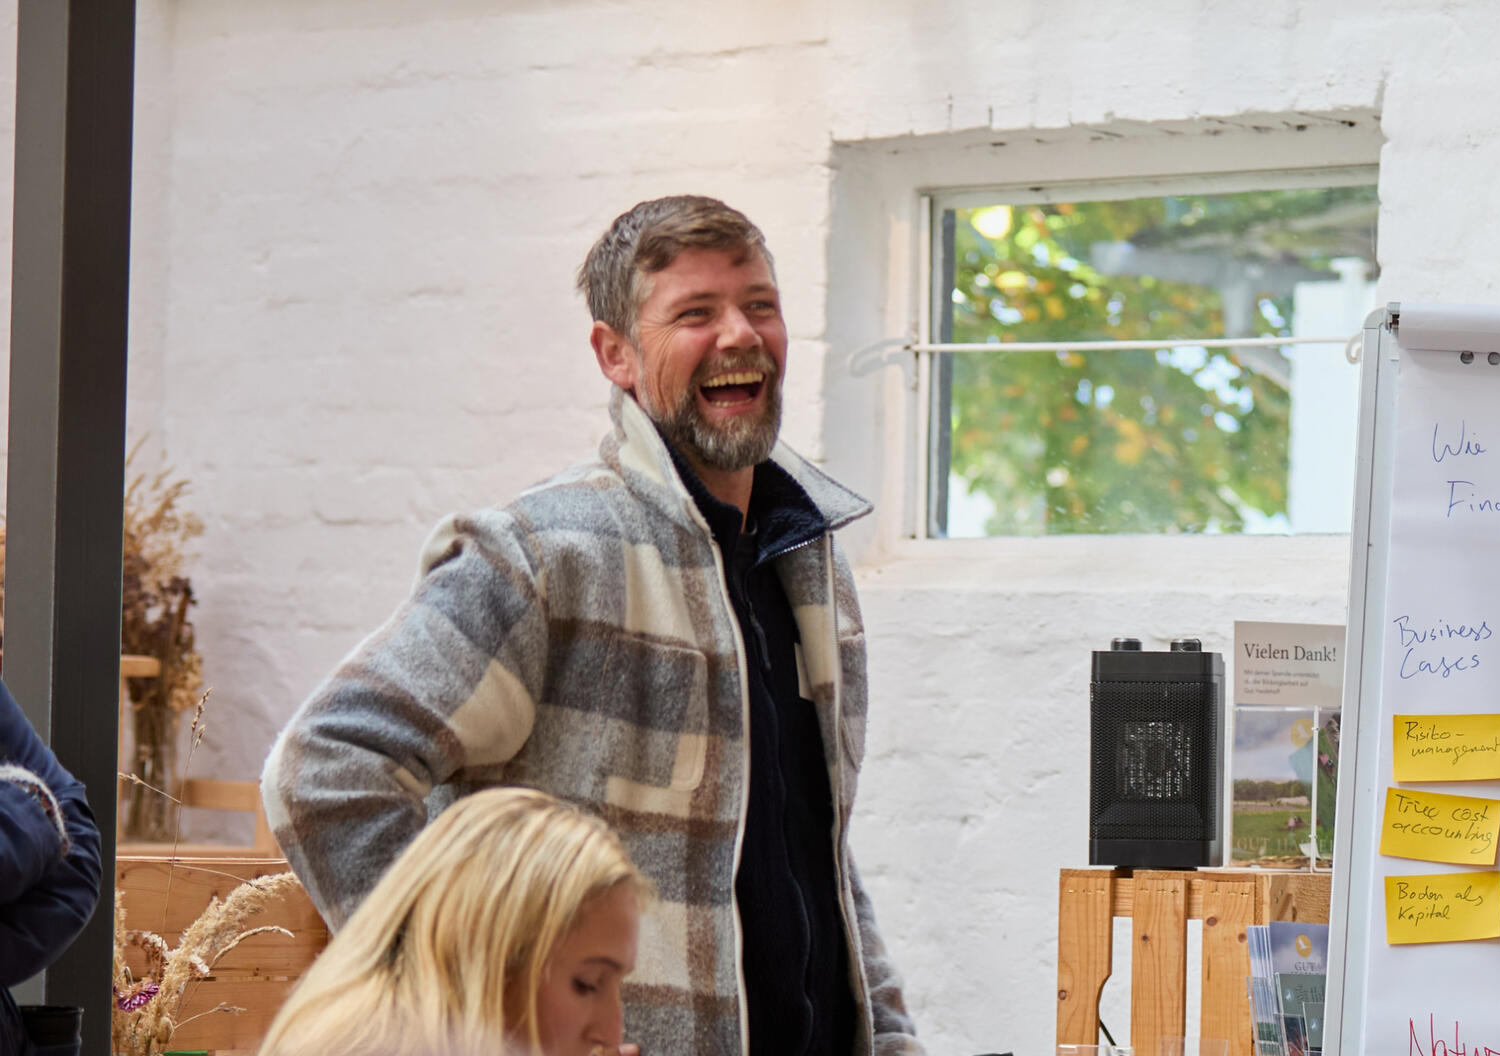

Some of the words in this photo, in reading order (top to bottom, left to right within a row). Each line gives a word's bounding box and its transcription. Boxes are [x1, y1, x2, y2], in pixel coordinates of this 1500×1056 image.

[1432, 421, 1486, 463] Wie
[1393, 615, 1493, 646] Business
[1244, 643, 1289, 660] Vielen
[1294, 645, 1337, 662] Dank!
[1400, 648, 1481, 679] Cases
